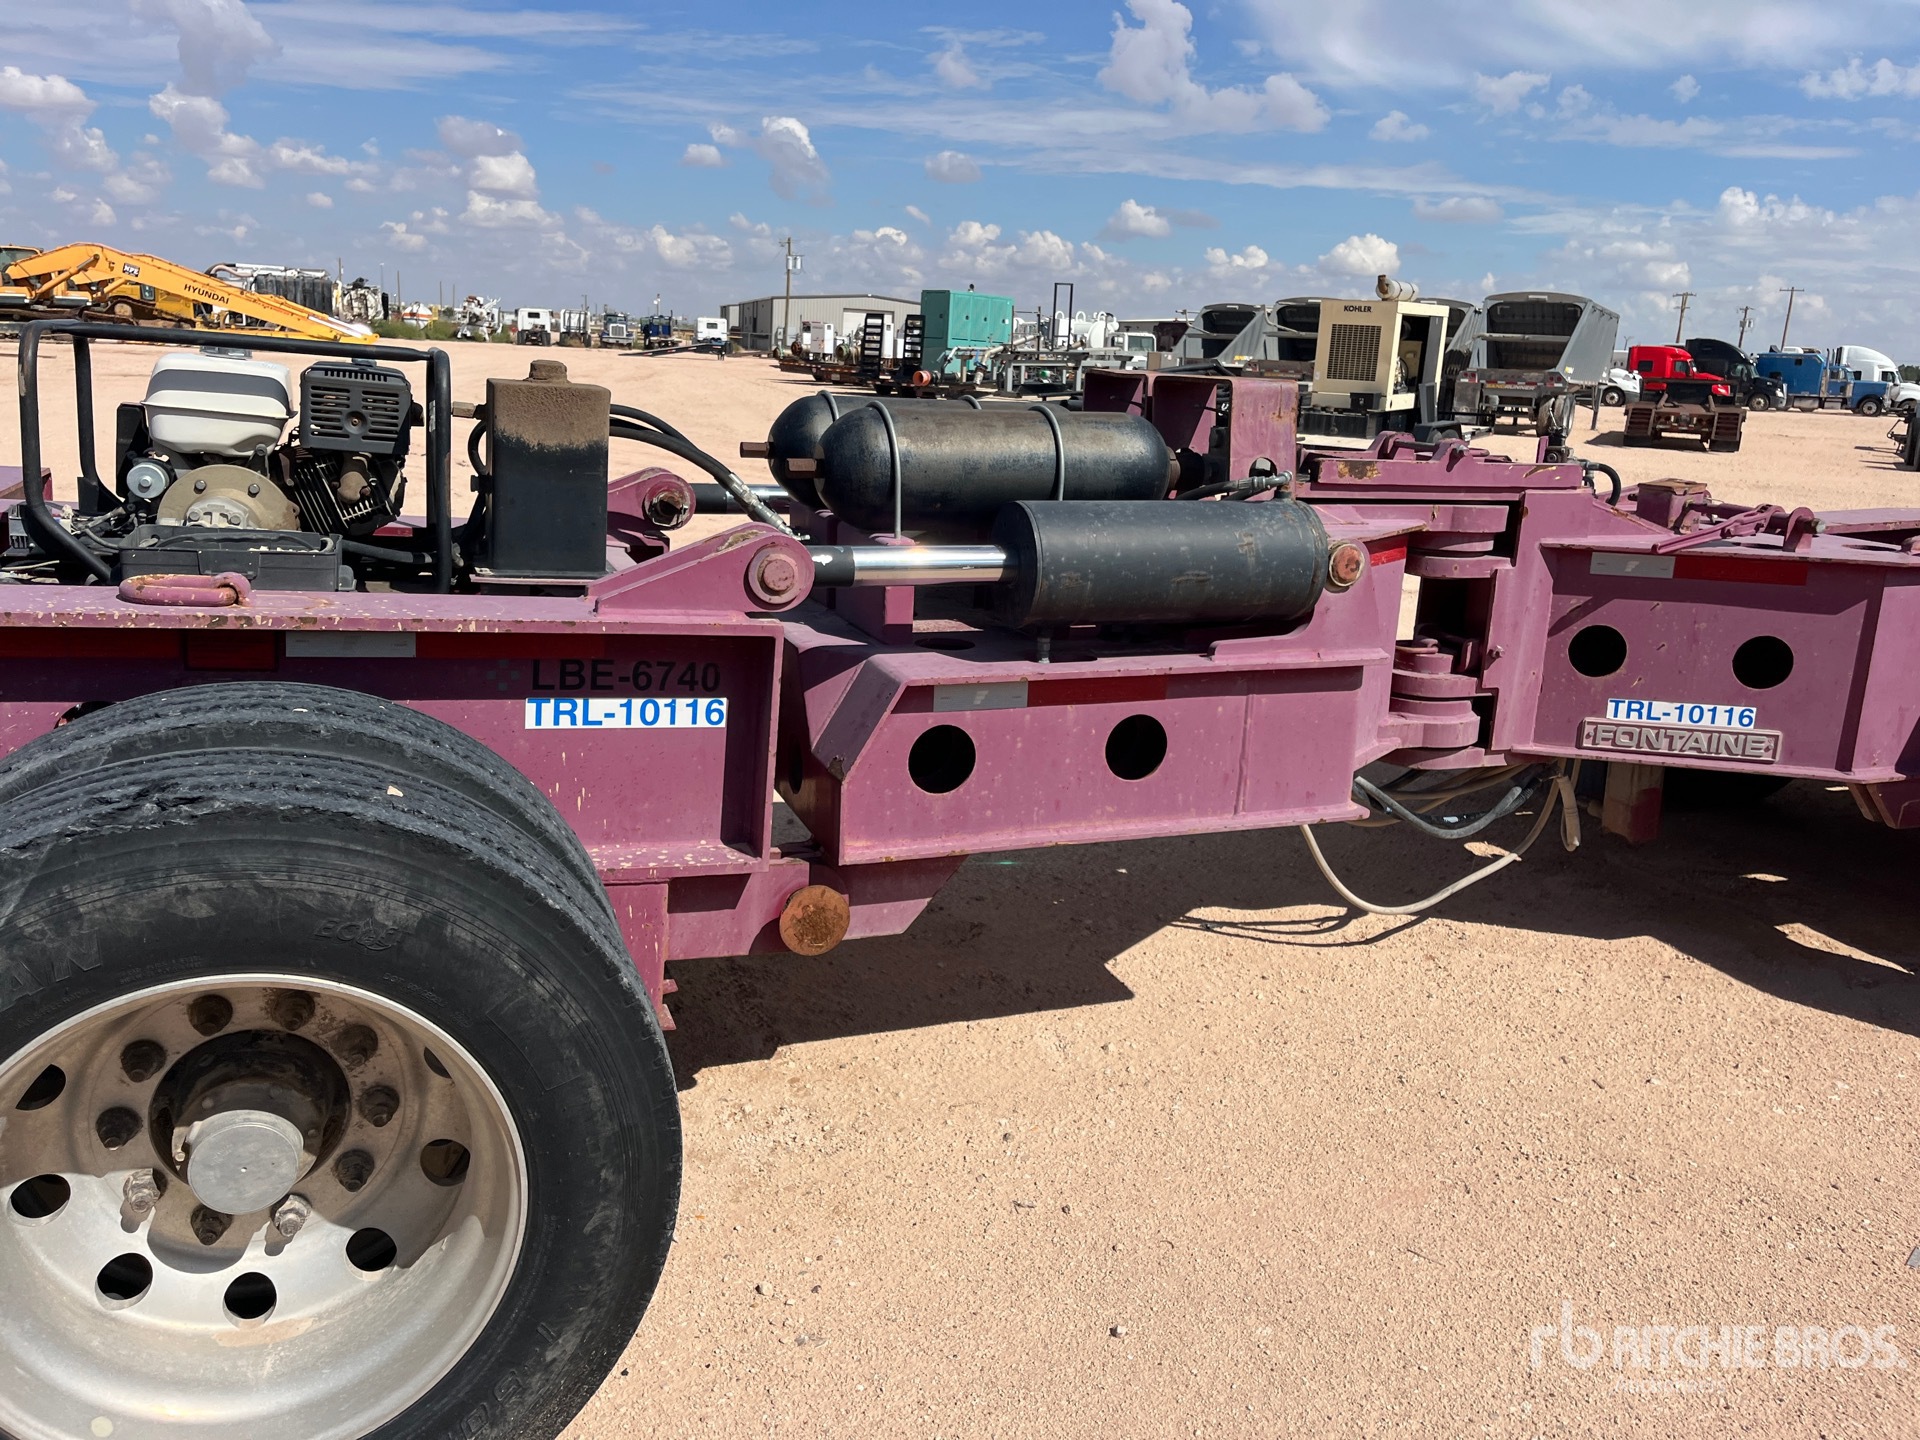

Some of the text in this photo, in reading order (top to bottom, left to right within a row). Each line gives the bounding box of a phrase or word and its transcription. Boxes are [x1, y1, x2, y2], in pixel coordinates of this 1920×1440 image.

[184, 284, 229, 305] HYUNDAI
[1343, 305, 1372, 313] KOHLER
[531, 659, 721, 692] LBE-6740
[527, 698, 725, 727] TRL-10116
[1609, 699, 1754, 727] TRL-10116
[1594, 724, 1768, 758] FONTAINE
